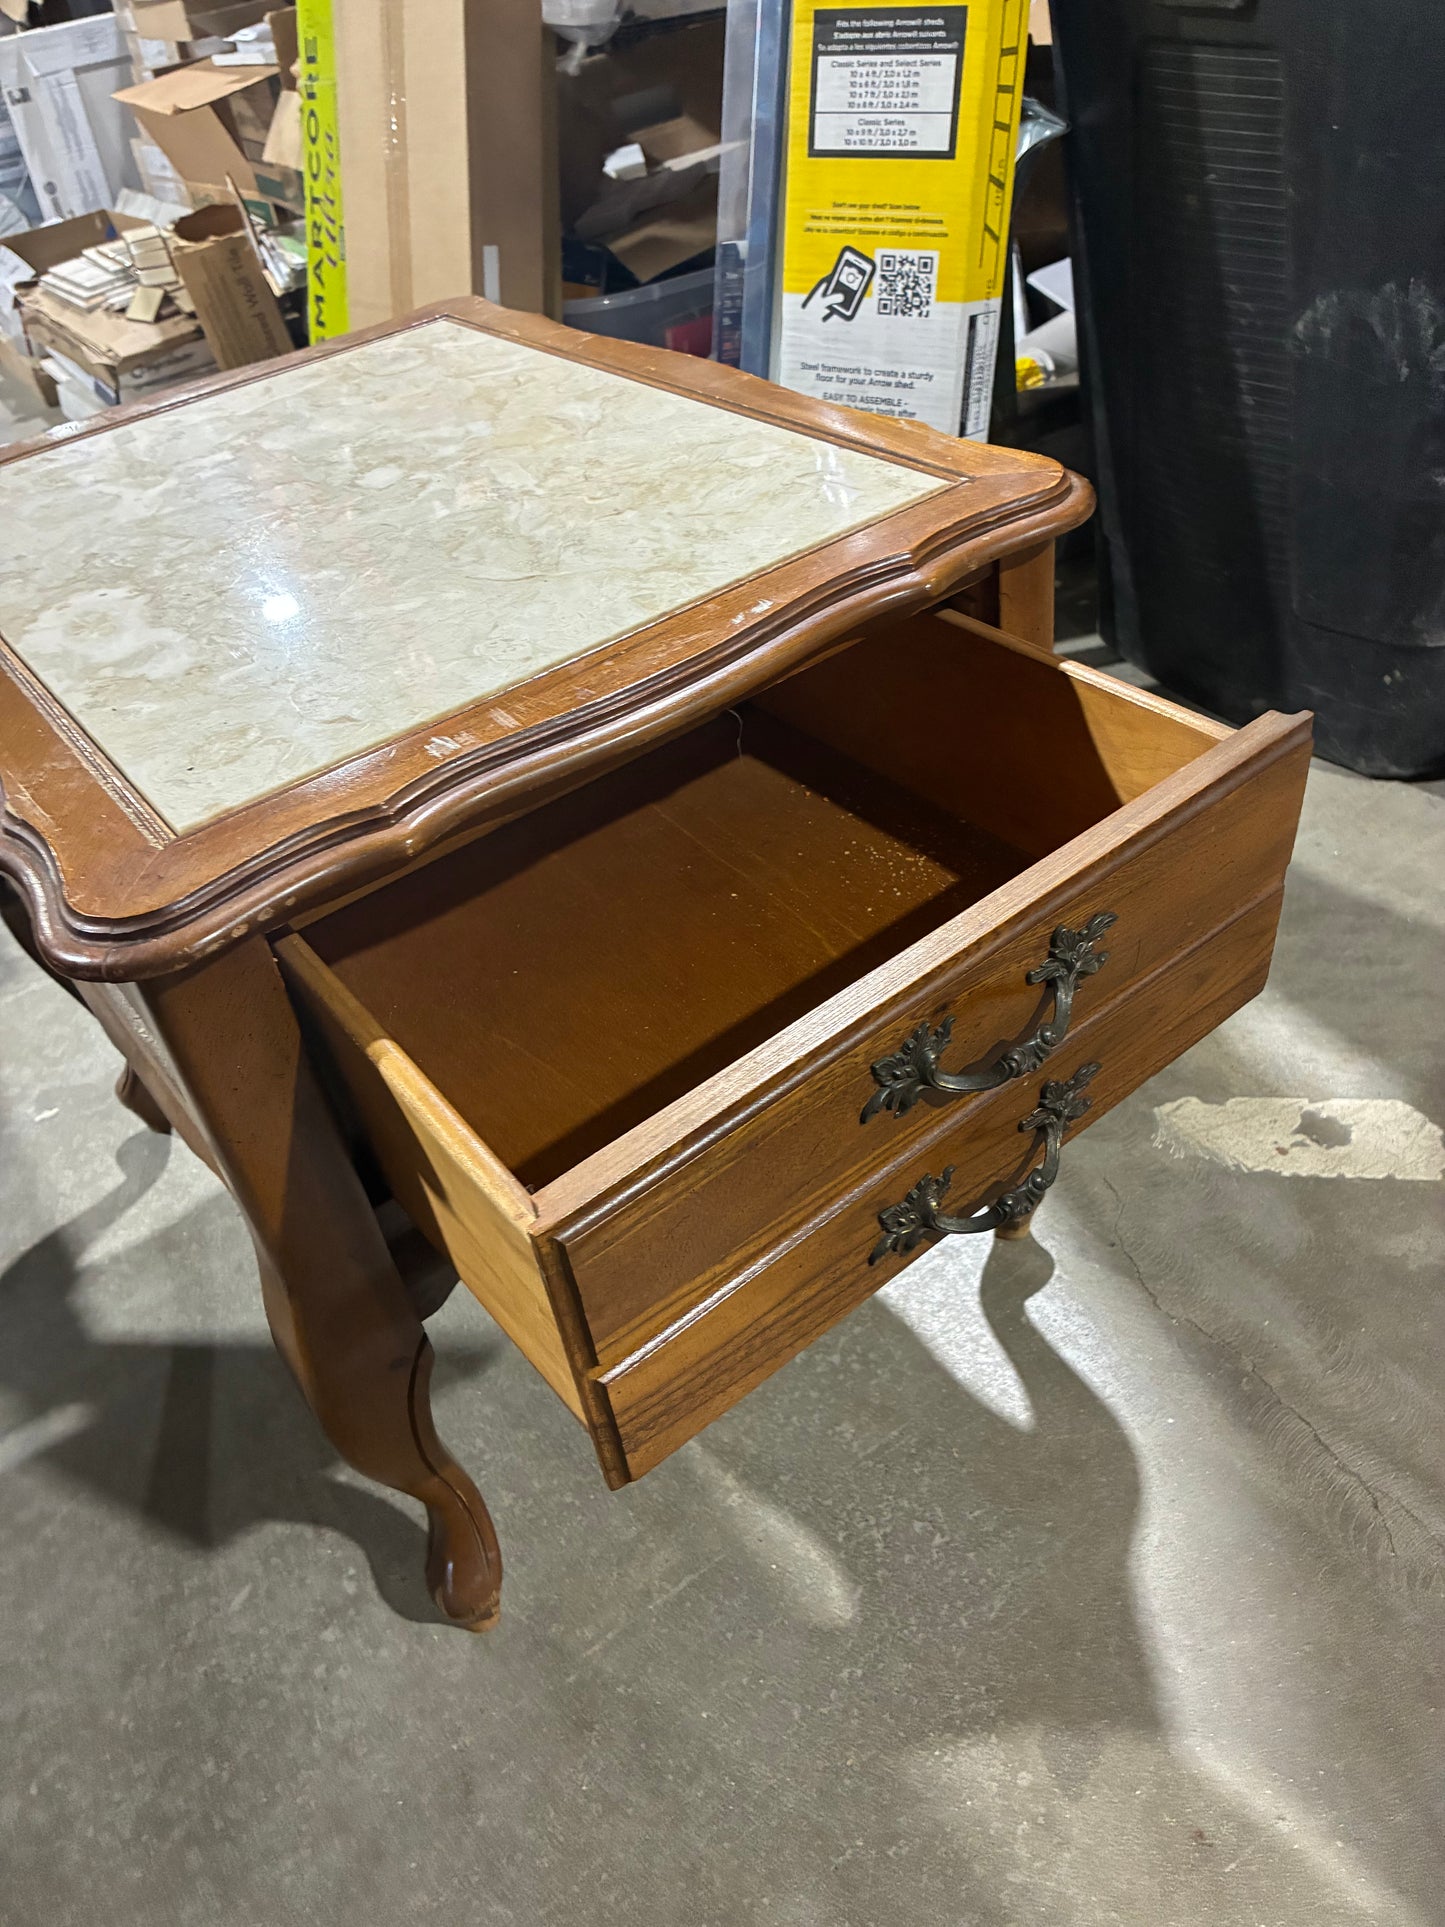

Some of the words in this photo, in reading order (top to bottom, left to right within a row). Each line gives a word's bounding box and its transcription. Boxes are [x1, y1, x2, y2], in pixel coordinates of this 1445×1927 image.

[831, 60, 855, 68] Classic
[856, 60, 878, 68] Series
[879, 60, 894, 68] and
[895, 60, 918, 68] Select
[919, 59, 942, 68] Series
[858, 118, 882, 127] Classic
[884, 118, 906, 126] Series
[800, 362, 820, 372] Steel
[820, 363, 862, 376] framework
[863, 366, 873, 376] to
[874, 368, 899, 379] create
[900, 371, 906, 379] a
[908, 370, 934, 382] sturdy
[815, 373, 834, 382] floor
[836, 374, 847, 384] for
[848, 376, 866, 386] your
[868, 378, 892, 388] Arrow
[894, 380, 916, 390] shed.
[822, 392, 845, 402] EASY
[846, 394, 858, 403] TO
[860, 395, 902, 408] ASSEMBLE
[876, 406, 896, 416] tools
[898, 409, 918, 418] after
